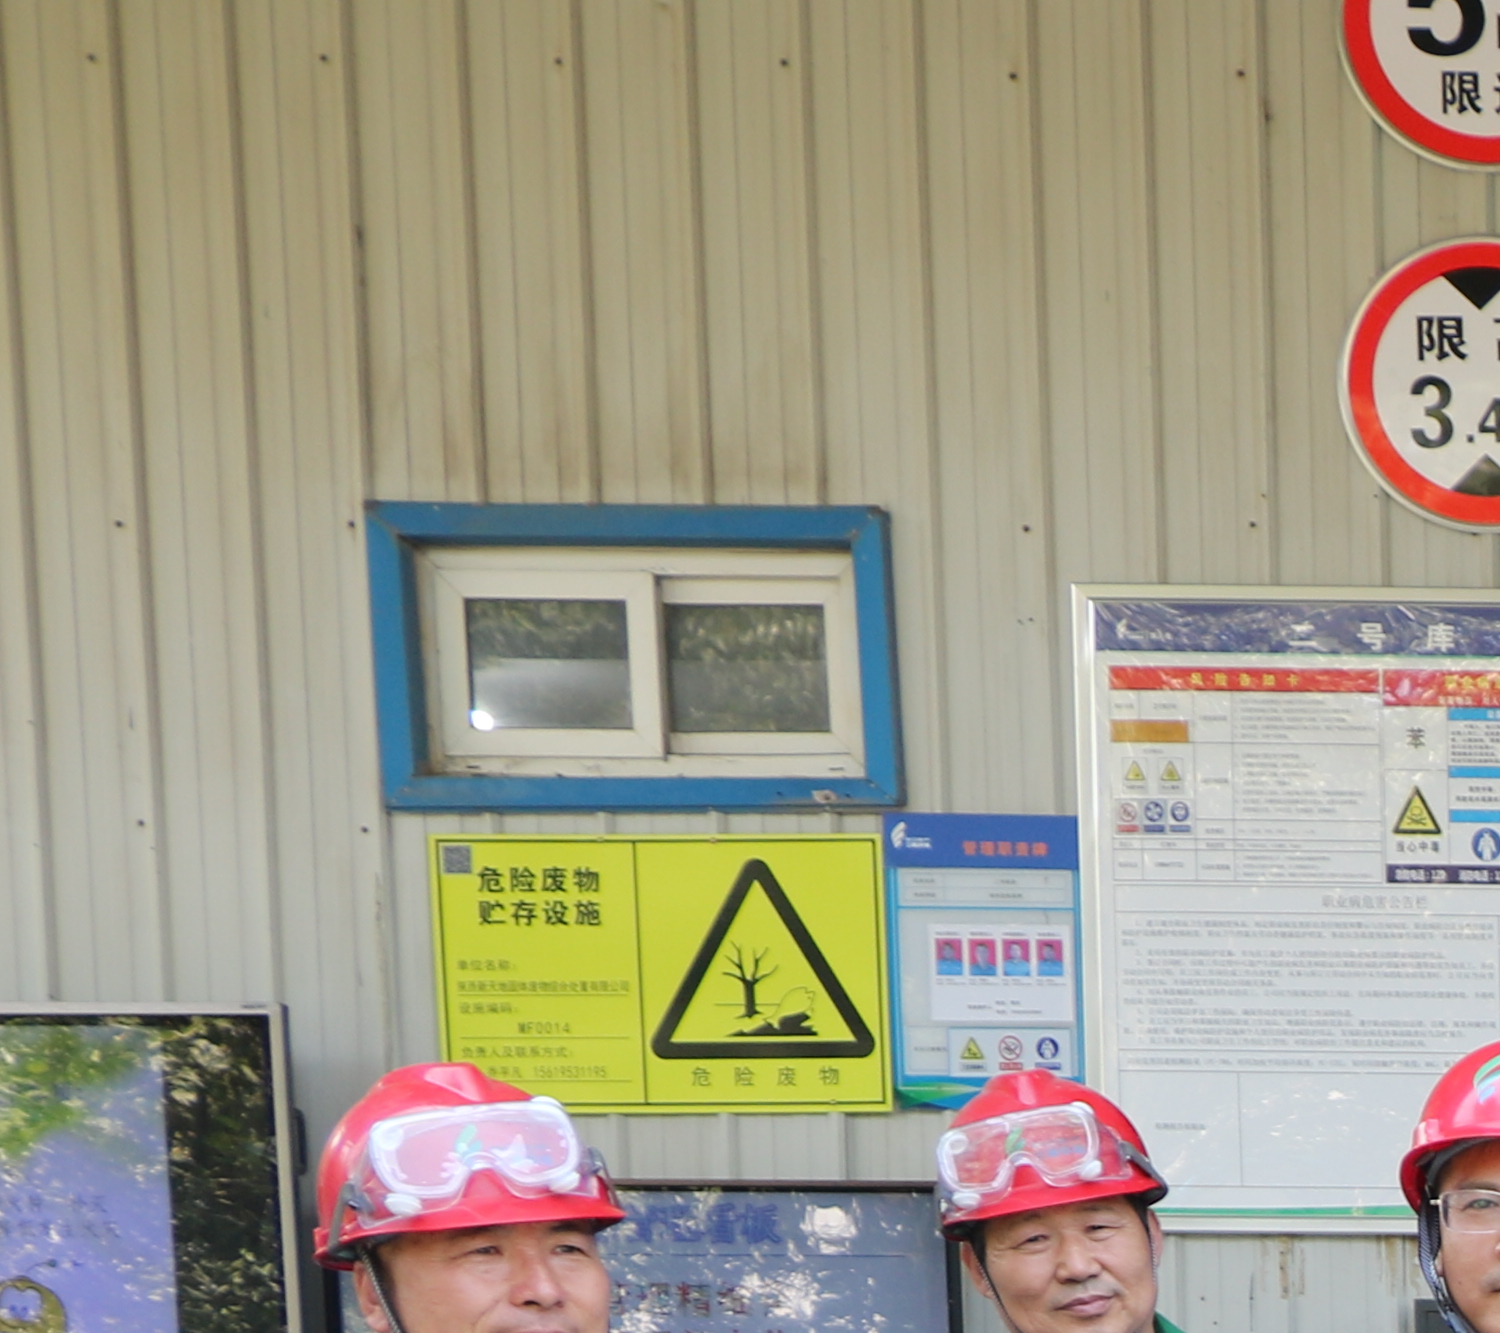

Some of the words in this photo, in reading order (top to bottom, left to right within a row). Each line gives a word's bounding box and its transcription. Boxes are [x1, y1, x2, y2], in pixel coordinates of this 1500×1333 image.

[477, 866, 600, 893] 危险废物
[478, 900, 602, 926] 贮存设施
[691, 1066, 840, 1087] 危险废物
